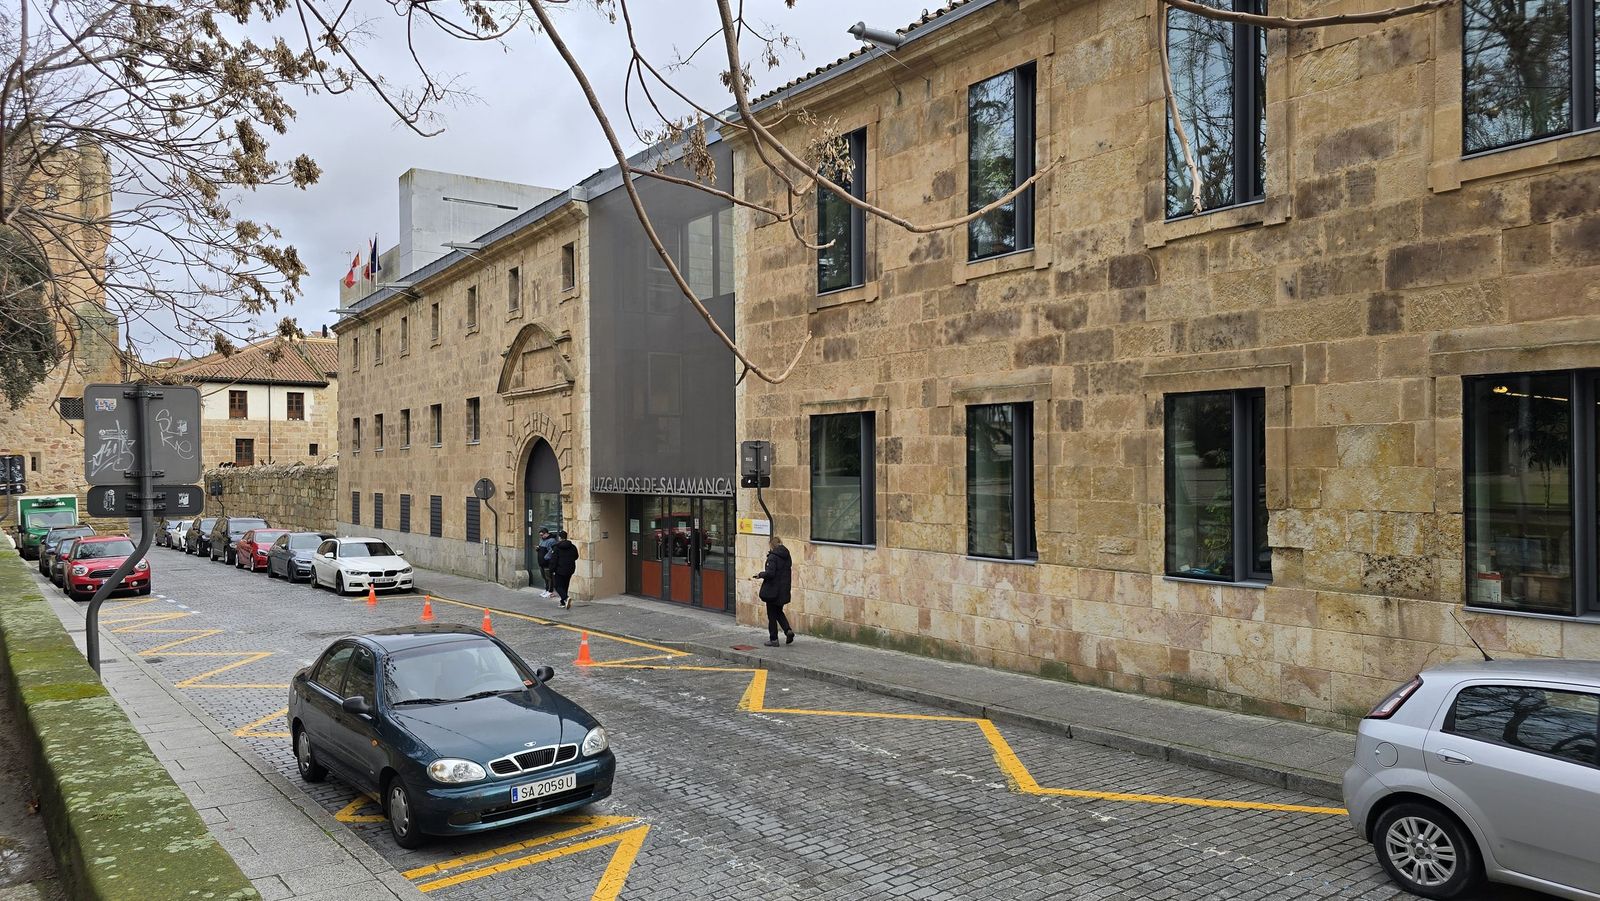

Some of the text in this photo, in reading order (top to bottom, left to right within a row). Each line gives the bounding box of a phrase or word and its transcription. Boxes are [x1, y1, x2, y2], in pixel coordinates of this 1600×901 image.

[643, 477, 657, 494] DE
[660, 477, 733, 496] SALAMANCA
[521, 776, 573, 799] SA 2059 U
